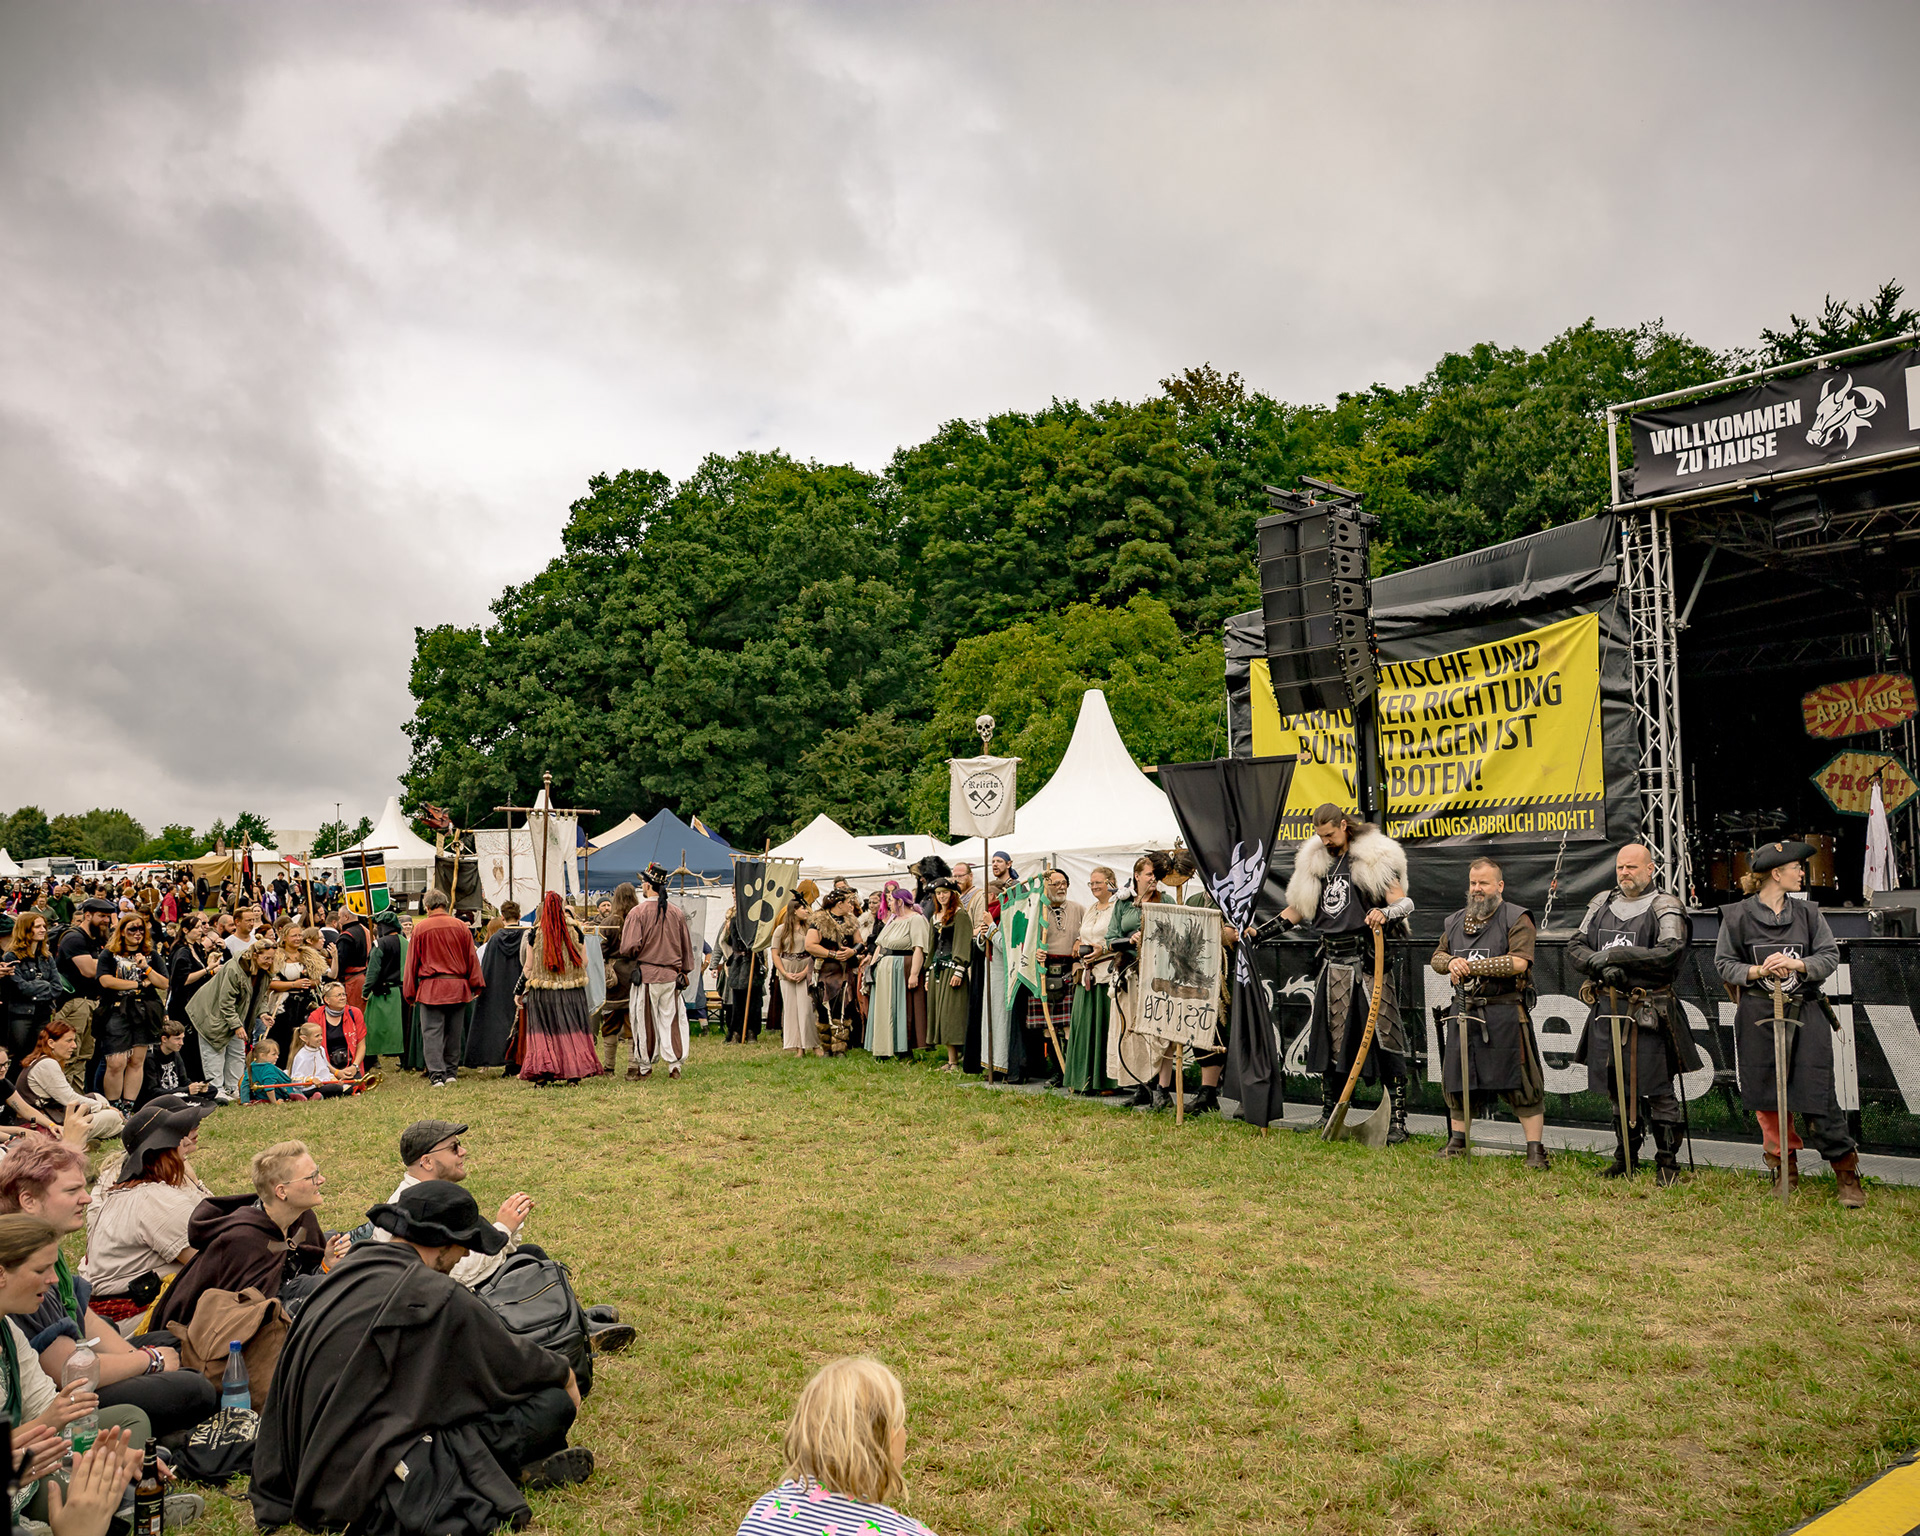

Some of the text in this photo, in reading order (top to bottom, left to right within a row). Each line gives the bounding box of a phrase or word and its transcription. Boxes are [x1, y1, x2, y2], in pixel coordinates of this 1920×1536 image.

[1650, 399, 1802, 455] WILLKOMMEN
[1675, 432, 1778, 476] ZU HAUSE
[1479, 640, 1541, 677] UND
[1423, 671, 1562, 721] RICHTUNG
[1815, 688, 1904, 724] APPLAUS
[1299, 714, 1537, 765] BÜHN TRAGEN IST
[1342, 759, 1484, 799] VBOTEN!
[1825, 773, 1908, 796] PROT!
[1386, 812, 1534, 839] NSTALTUNGSABBRUCH
